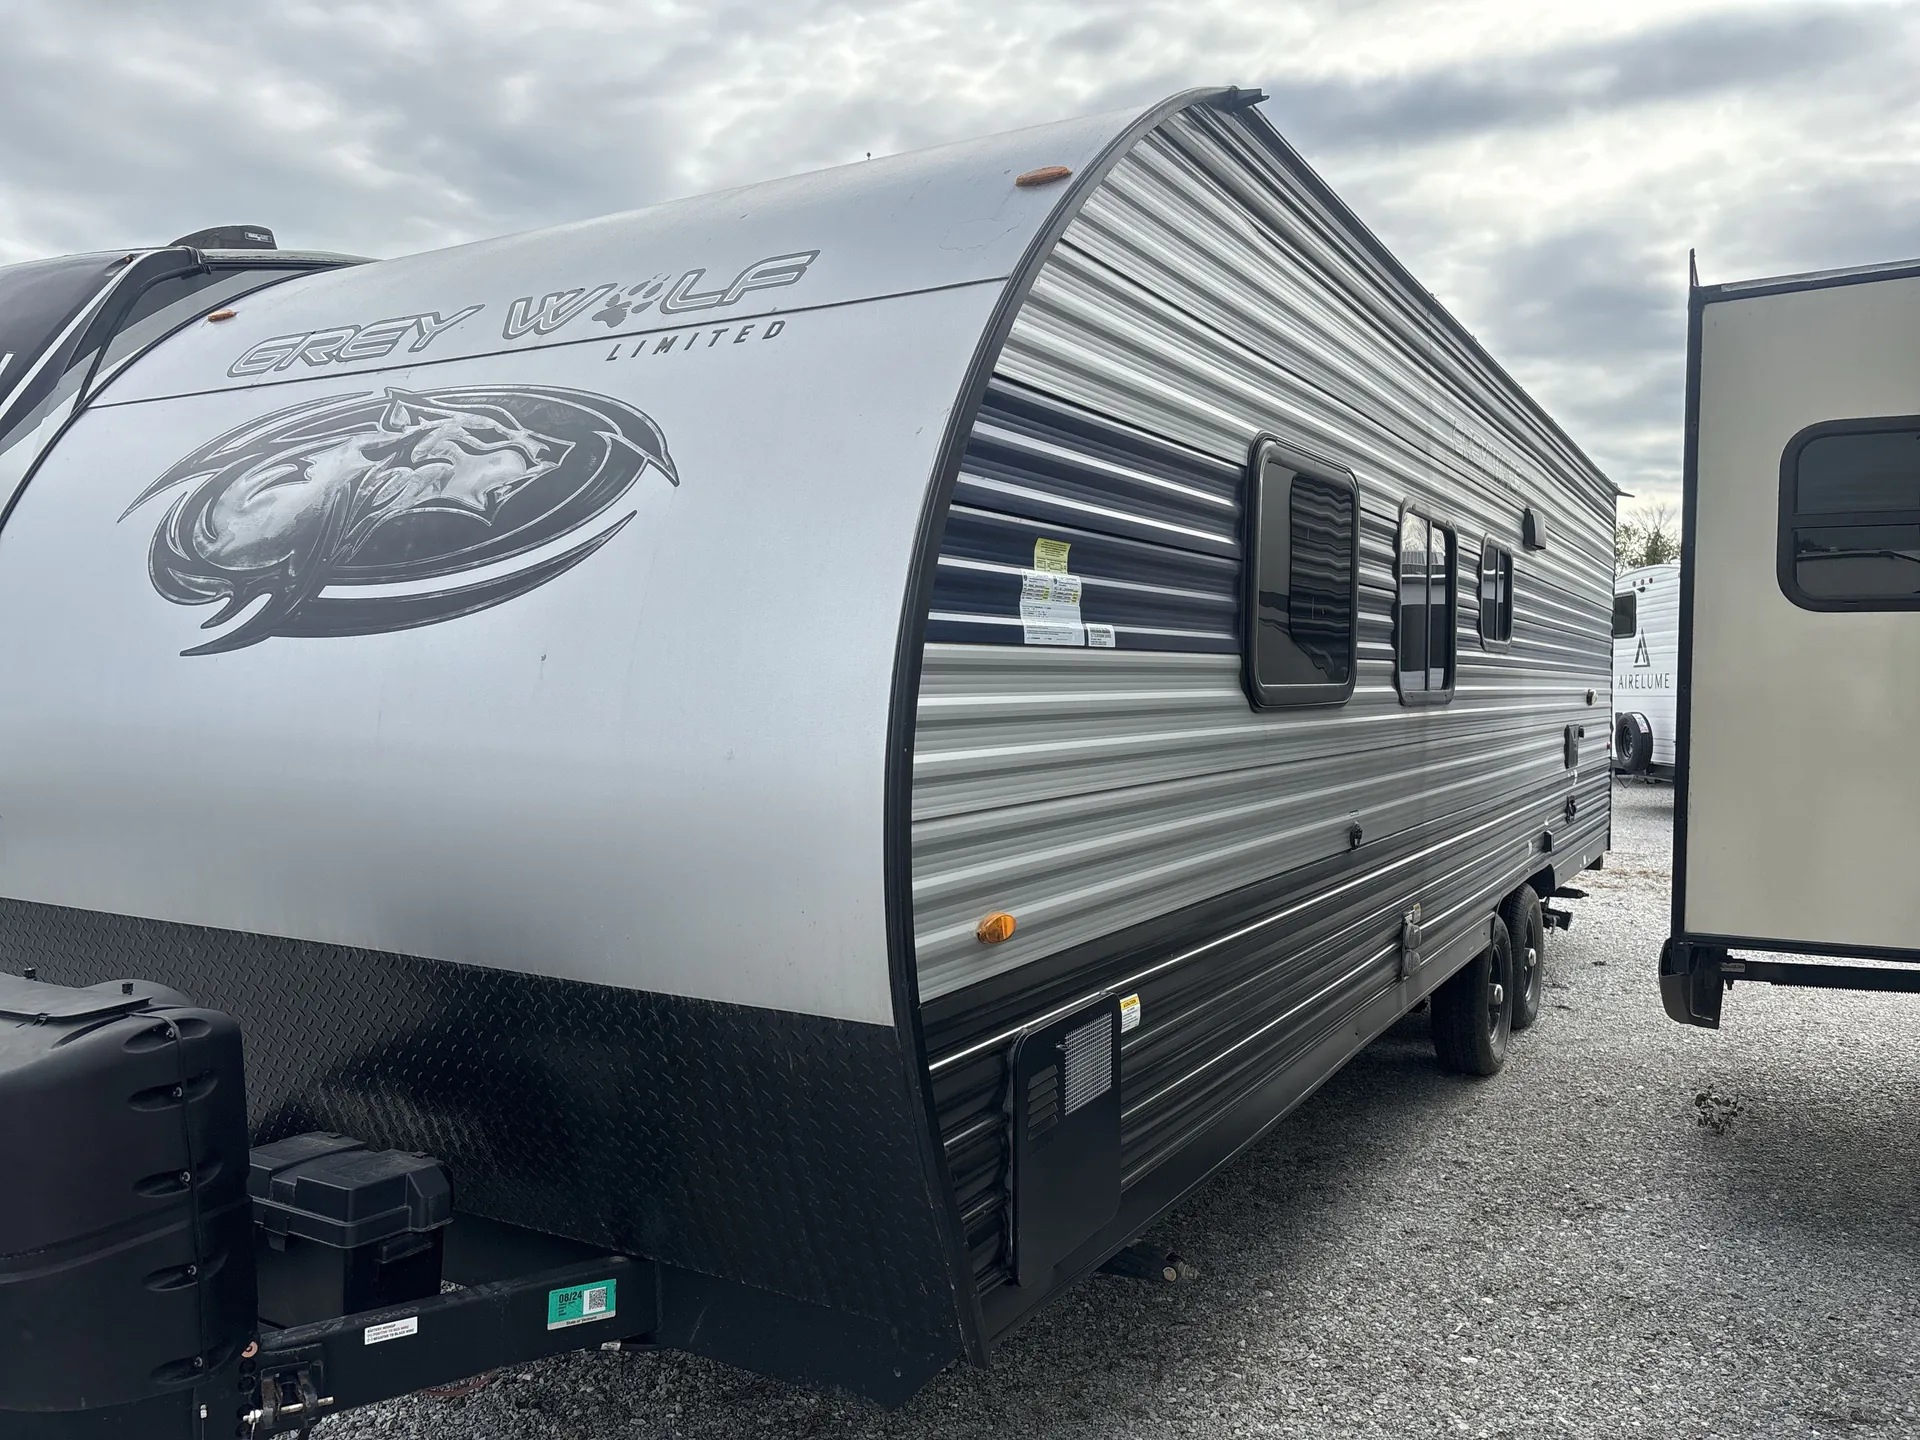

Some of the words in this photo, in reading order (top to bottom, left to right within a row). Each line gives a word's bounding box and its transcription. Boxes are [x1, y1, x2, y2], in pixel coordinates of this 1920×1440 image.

[227, 304, 486, 378] GREY
[606, 320, 786, 362] LIMITED
[1618, 672, 1670, 690] AIRELUME
[558, 1290, 583, 1303] 08/24
